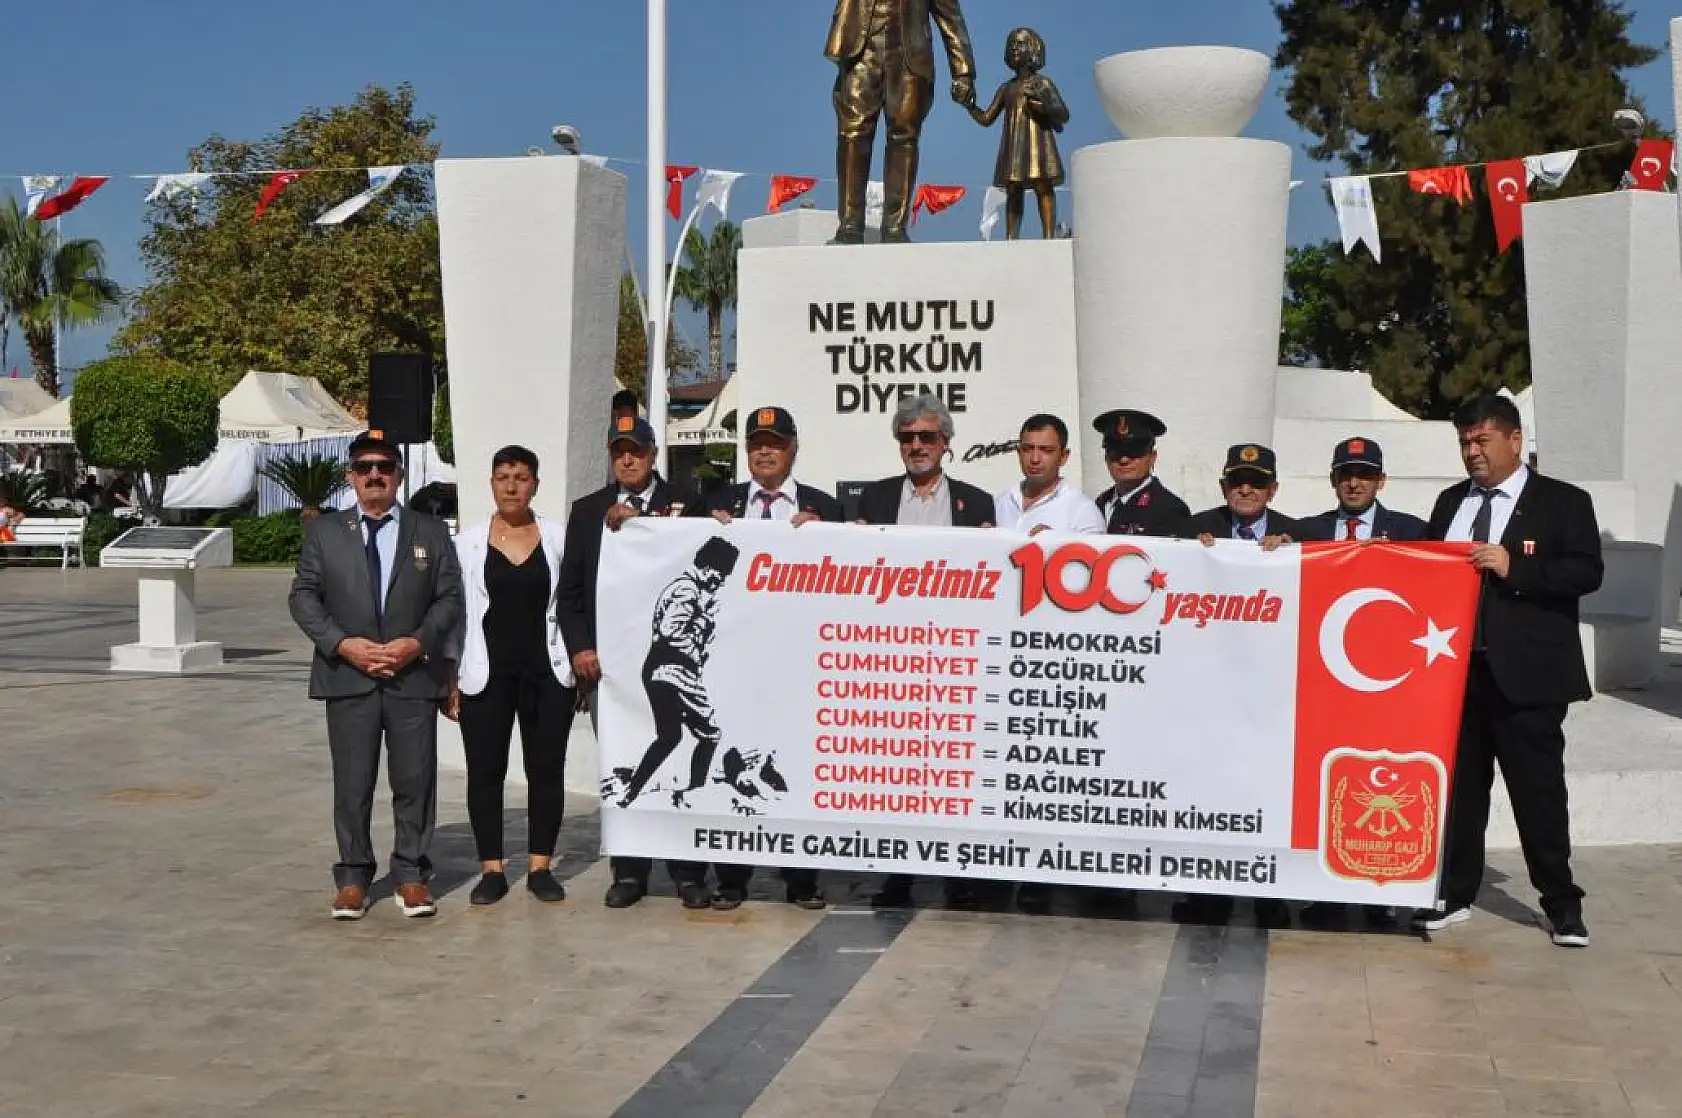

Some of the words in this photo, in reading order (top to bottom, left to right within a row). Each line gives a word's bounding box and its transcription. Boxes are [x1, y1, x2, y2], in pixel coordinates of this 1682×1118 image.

[809, 302, 855, 332] NE
[866, 299, 994, 332] MUTLU
[825, 334, 982, 375] TÜRKÜM
[746, 553, 1000, 604] Cumhuriyetimiz
[1008, 542, 1152, 616] 100
[1160, 588, 1283, 628] yaşında
[819, 622, 979, 647] CUMHURİYET
[987, 636, 1002, 646] =
[1010, 629, 1161, 655] DEMOKRASİ
[818, 651, 978, 675] CUMHURİYET
[985, 665, 1001, 674] =
[1008, 655, 1145, 684] ÖZGÜRLÜK
[816, 679, 977, 704] CUMHURİYET
[985, 693, 1000, 703] =
[1007, 684, 1107, 713] GELİŞİM
[815, 707, 976, 732] CUMHURİYET
[983, 721, 999, 731] =
[1006, 712, 1099, 742] EŞİTLİK
[814, 734, 975, 760] CUMHURİYET
[983, 749, 998, 759] =
[1005, 744, 1106, 768] ADALET
[813, 763, 974, 788] CUMHURİYET
[982, 778, 997, 788] =
[1004, 770, 1167, 800] BAĞIMSIZLIK
[812, 790, 973, 816] CUMHURİYET
[980, 806, 995, 816] =
[1003, 801, 1168, 829] KİMSESİZLERİN
[1173, 807, 1263, 834] KİMSESİ
[693, 824, 795, 855] FETHİYE
[802, 831, 909, 860] GAZİLER
[916, 840, 950, 863] VE
[956, 839, 1031, 871] ŞEHİT
[1037, 841, 1152, 876] AİLELERİ
[1160, 855, 1277, 884] DERNEĞİ
